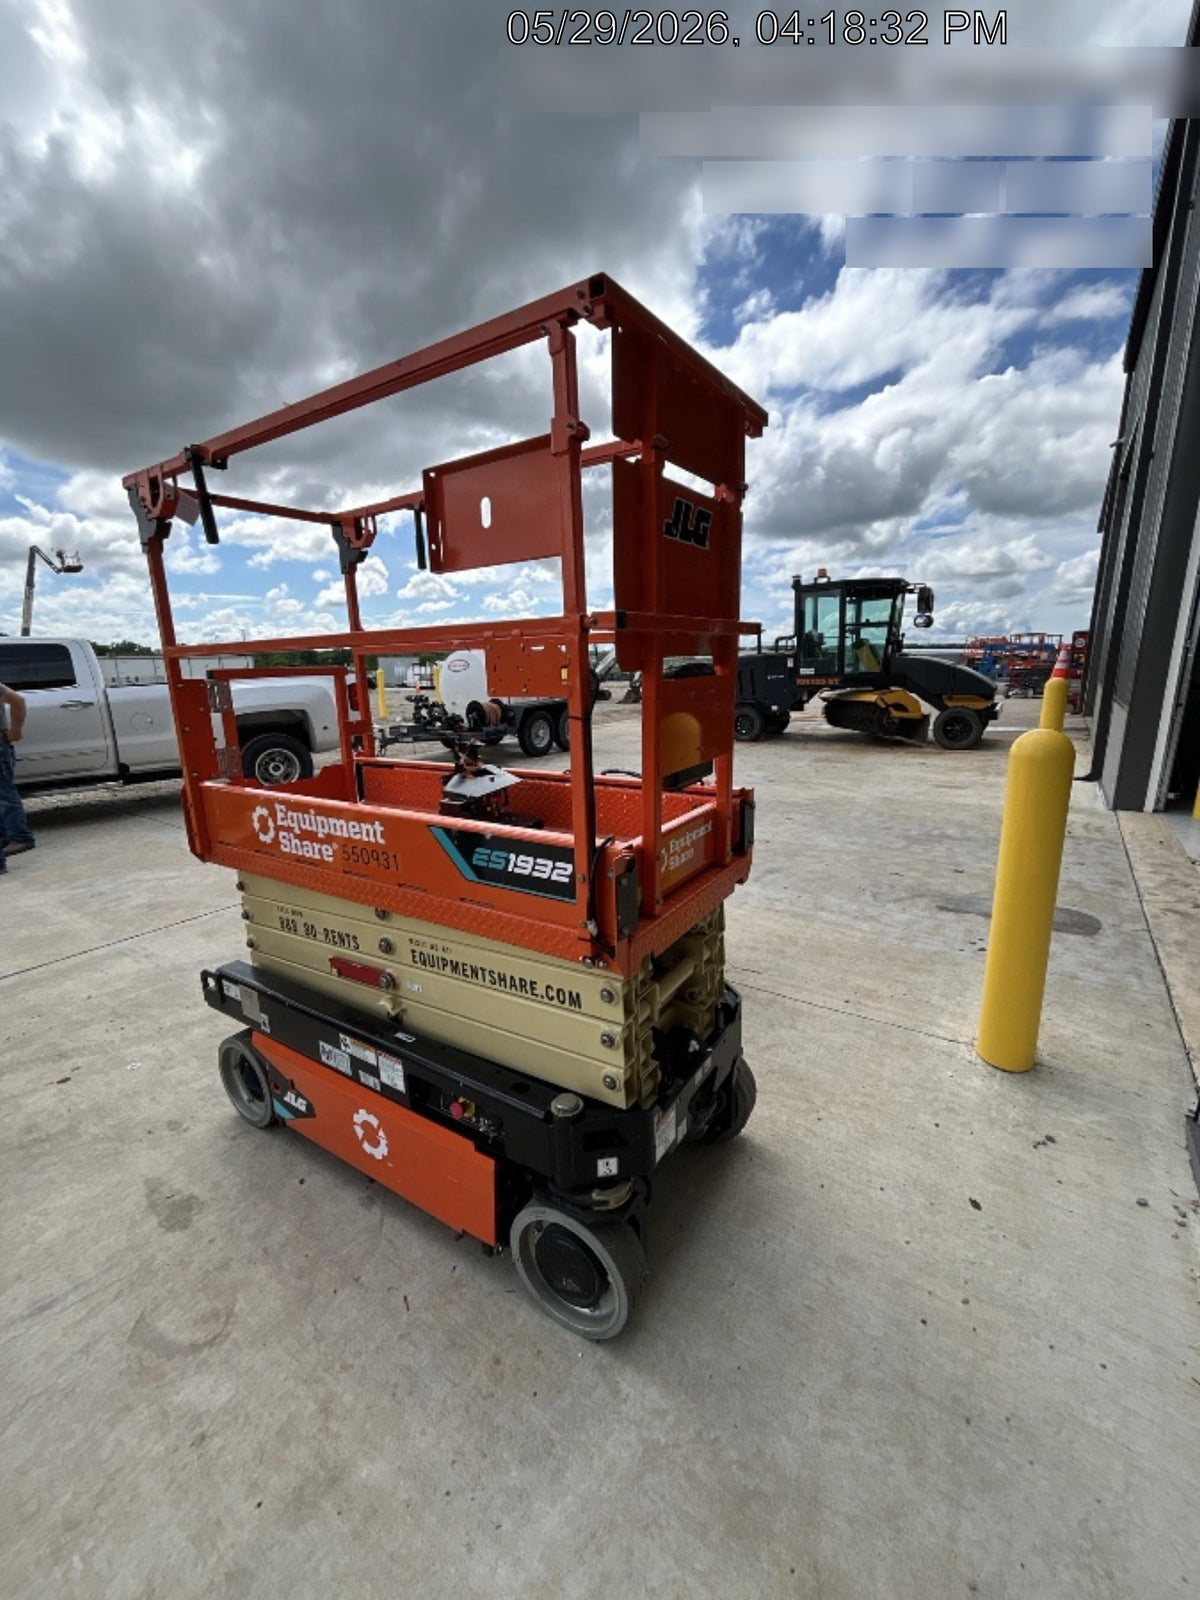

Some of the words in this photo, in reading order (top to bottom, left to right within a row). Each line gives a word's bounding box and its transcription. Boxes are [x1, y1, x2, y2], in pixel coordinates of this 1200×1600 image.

[664, 497, 713, 549] JLG
[275, 803, 386, 844] Equipment
[342, 844, 399, 872] 550931
[472, 847, 573, 883] ES1932
[410, 949, 582, 1009] EQUIPMENTSHARE.COM
